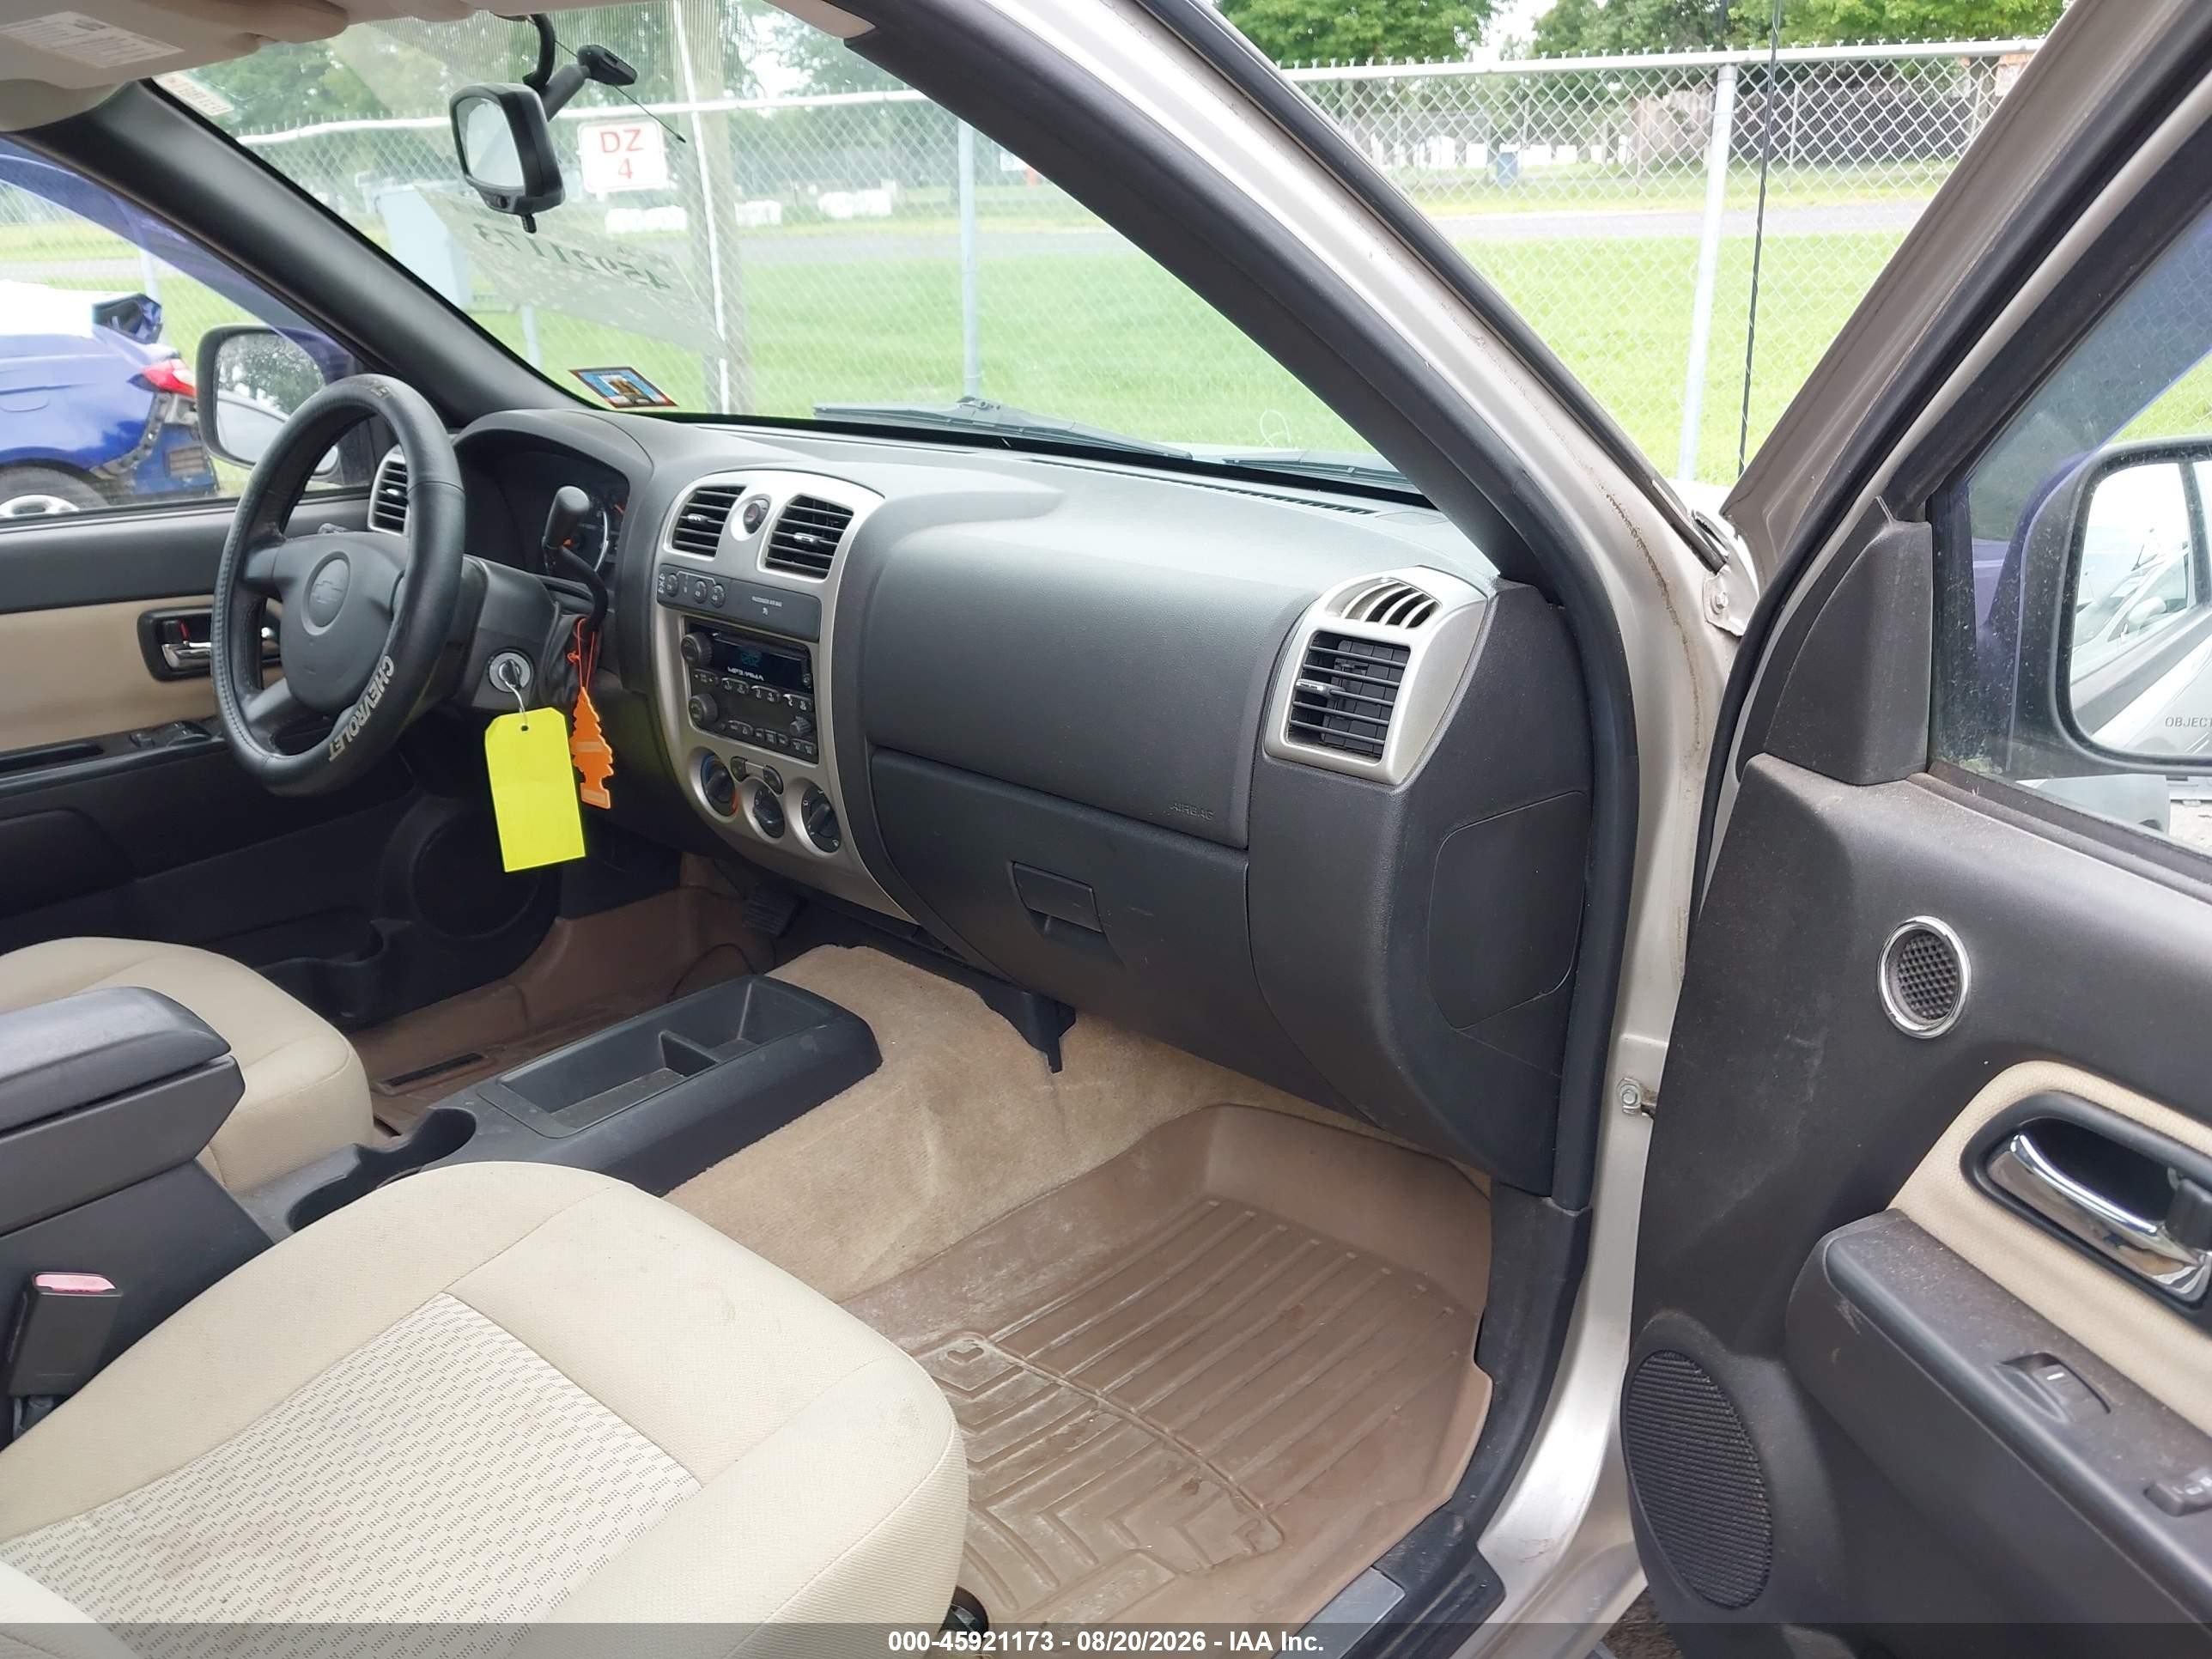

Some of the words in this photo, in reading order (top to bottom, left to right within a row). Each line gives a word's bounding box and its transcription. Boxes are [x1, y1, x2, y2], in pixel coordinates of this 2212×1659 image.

[599, 129, 644, 153] DZ
[618, 157, 632, 179] 4
[328, 655, 394, 762] CHEVROLET
[2165, 717, 2212, 727] OBJEC
[1169, 802, 1215, 821] AIRBAG
